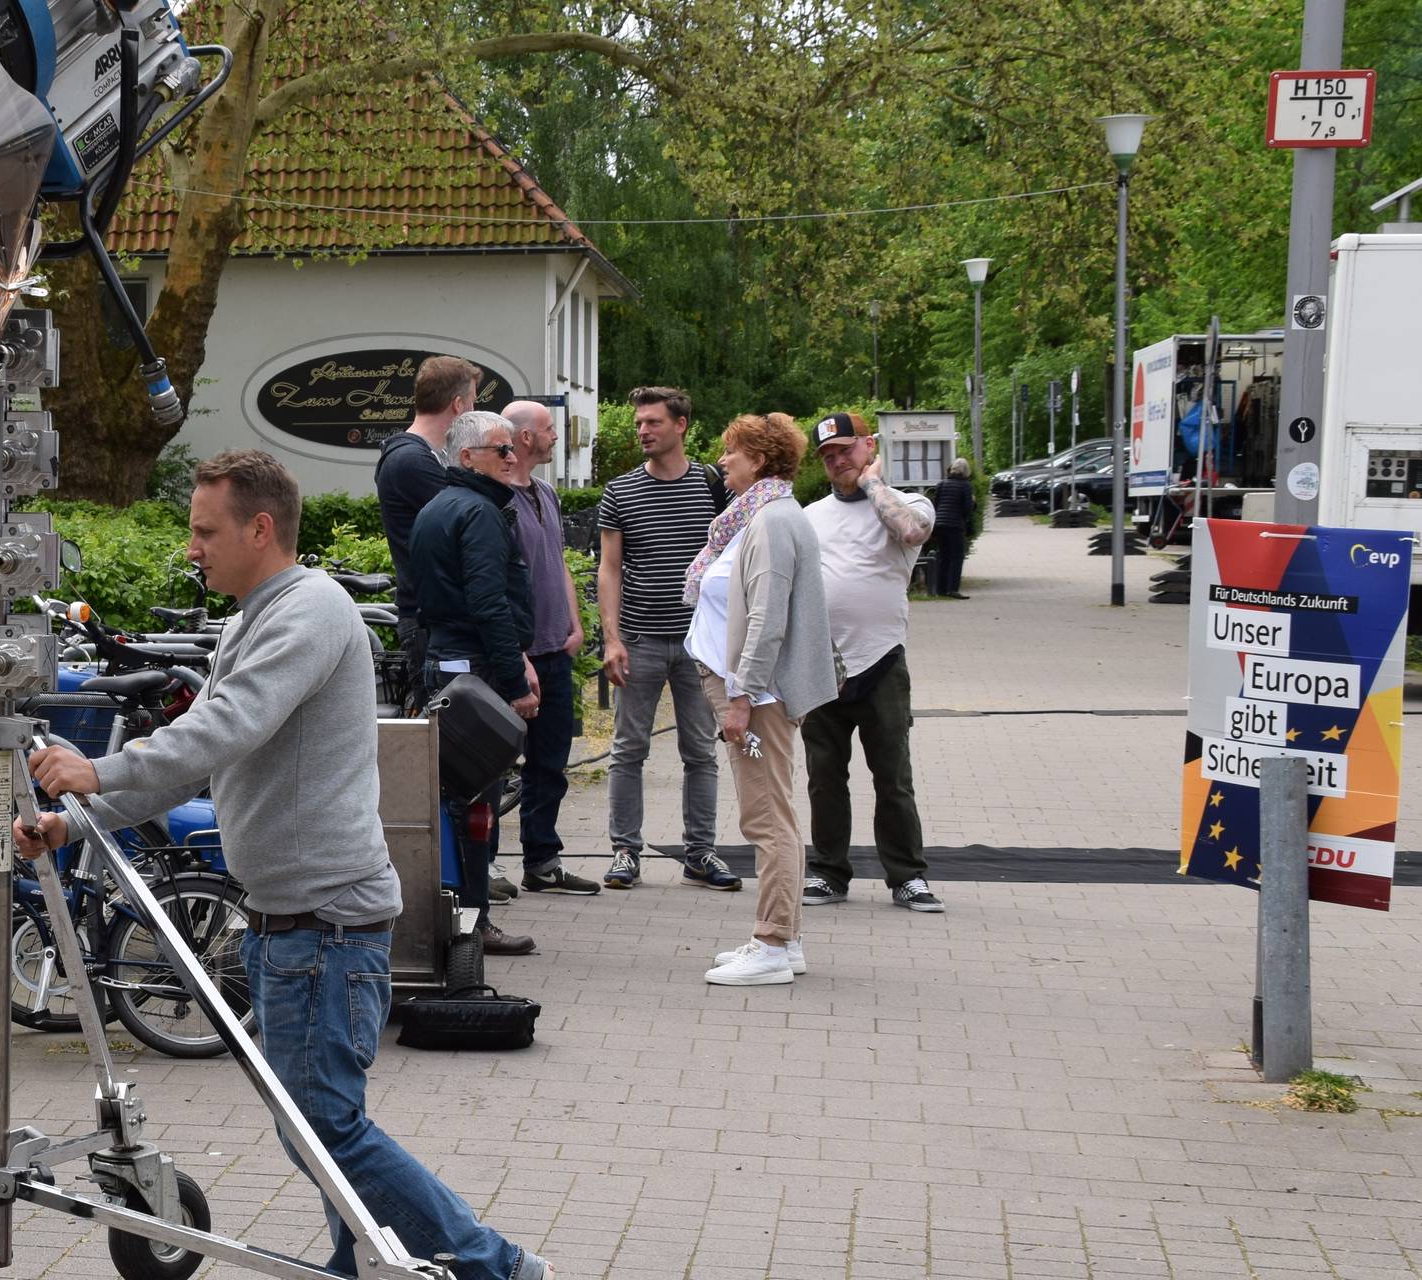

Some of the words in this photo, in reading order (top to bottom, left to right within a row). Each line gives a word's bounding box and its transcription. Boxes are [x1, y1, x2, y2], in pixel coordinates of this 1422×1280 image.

[94, 43, 121, 81] ARRI
[1294, 79, 1308, 97] H
[1315, 79, 1347, 96] 150
[1368, 552, 1400, 568] evp
[1215, 587, 1229, 600] Für
[1231, 589, 1296, 607] Deutschlands
[1299, 595, 1348, 611] Zukunft
[1214, 613, 1282, 646] Unser
[1251, 662, 1349, 704] Europa
[1230, 704, 1277, 739] gibt
[1207, 744, 1337, 788] Sicheeit
